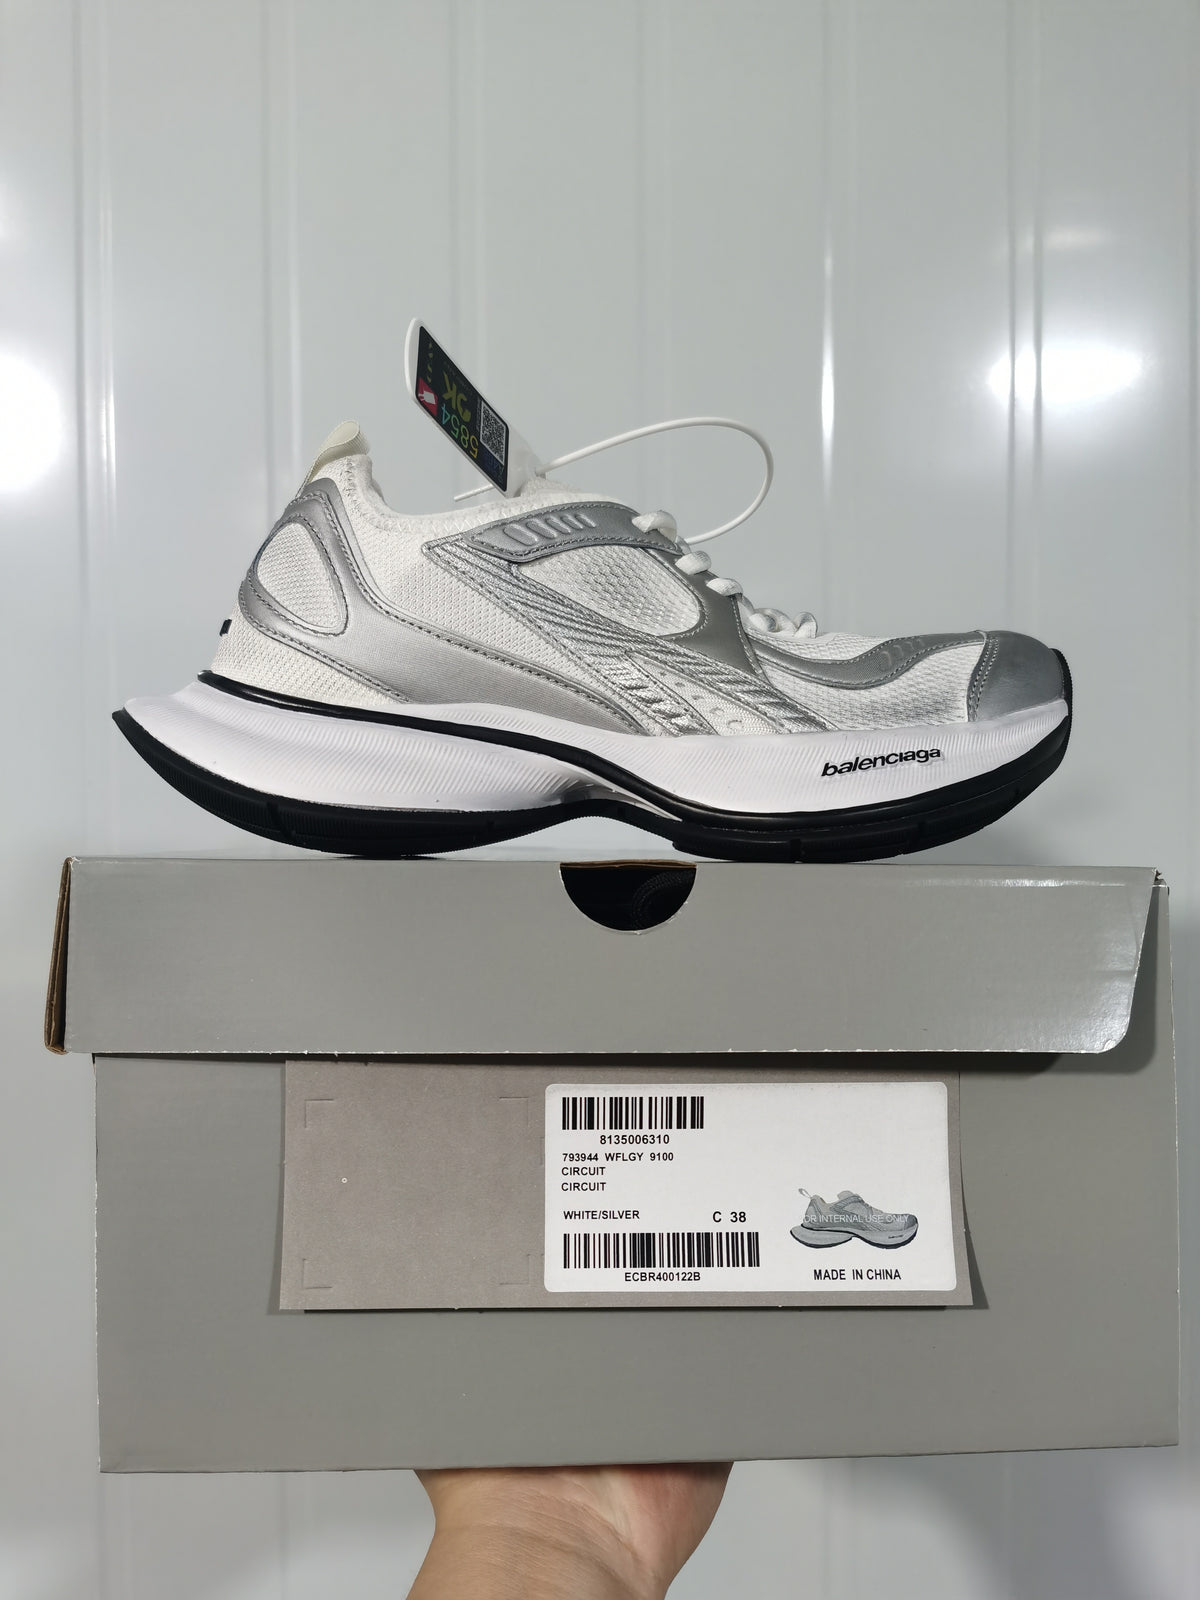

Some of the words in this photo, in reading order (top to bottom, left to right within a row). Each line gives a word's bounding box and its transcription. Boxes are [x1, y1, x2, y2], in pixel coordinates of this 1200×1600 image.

[441, 403, 479, 459] 5854
[821, 748, 941, 777] balenciaga
[599, 1134, 670, 1145] 8135006310
[562, 1152, 599, 1162] 793944
[604, 1152, 644, 1162] WFLGY
[649, 1152, 674, 1162] 9100
[561, 1166, 606, 1176] CIRCUIT
[561, 1182, 607, 1192] CIRCUIT
[563, 1209, 640, 1220] WHITE/SILVER
[712, 1210, 722, 1223] C
[730, 1211, 747, 1223] 38
[819, 1214, 862, 1223] INTERNAL
[865, 1214, 884, 1223] USE
[886, 1214, 909, 1223] ONLY
[624, 1271, 701, 1282] ECBR400122B
[813, 1268, 846, 1281] MADE
[852, 1268, 864, 1281] IN
[866, 1268, 902, 1281] CHINA
